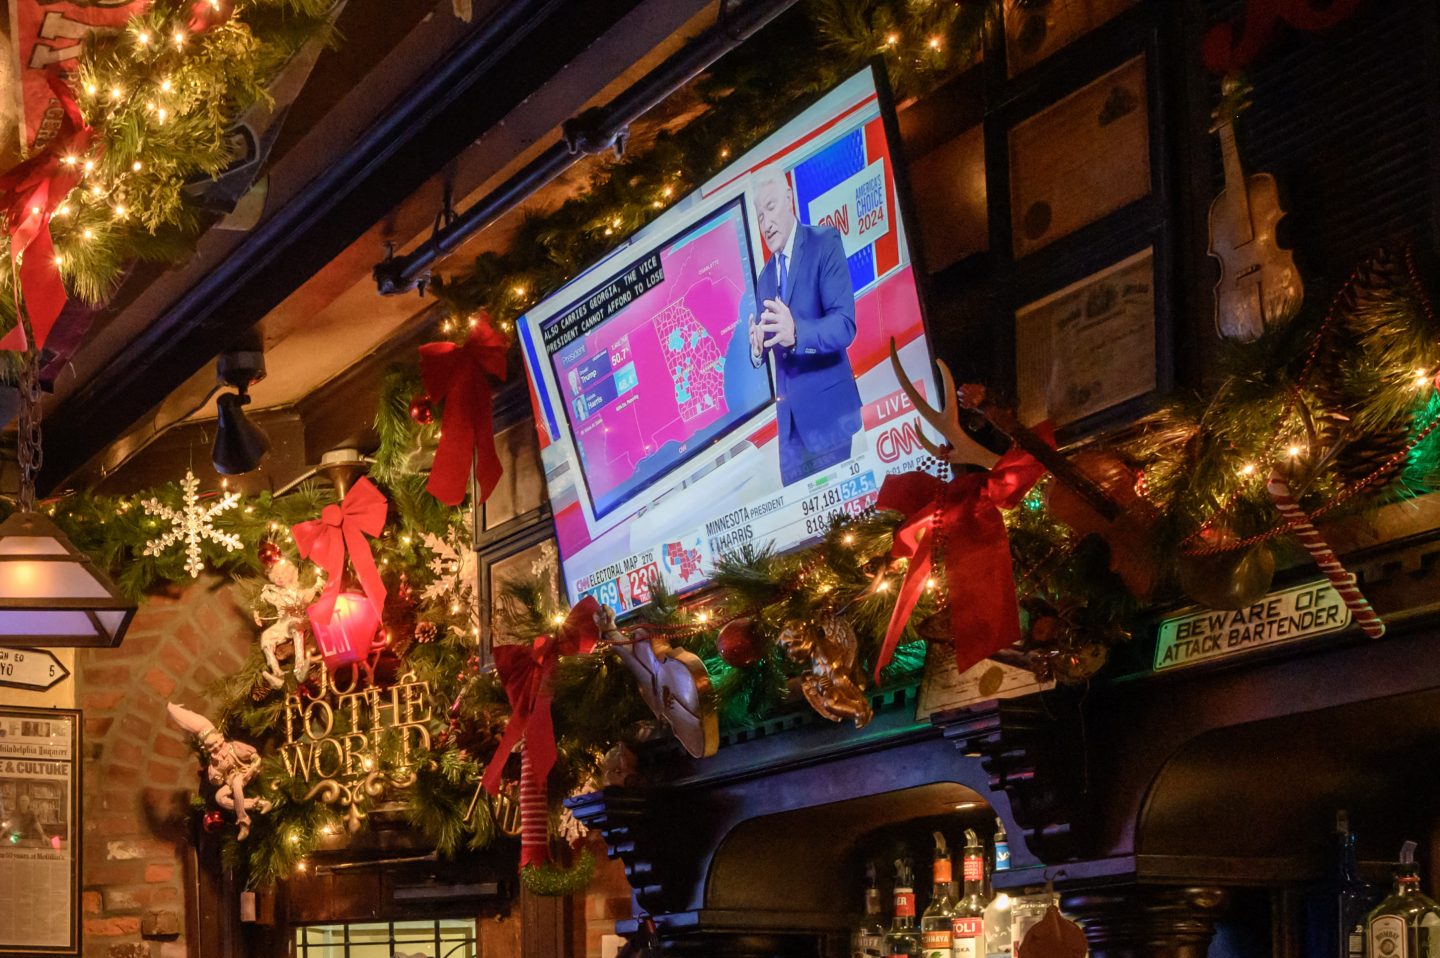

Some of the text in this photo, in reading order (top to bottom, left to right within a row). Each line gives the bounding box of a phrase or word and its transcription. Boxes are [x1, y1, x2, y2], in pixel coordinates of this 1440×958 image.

[856, 174, 882, 200] AMERICA'S
[856, 188, 883, 218] CHOICE
[858, 206, 883, 235] 2024
[544, 256, 658, 340] ALSO CARRIES GEORGIA, THE VICE
[546, 268, 664, 354] PRESIDENT CANNOT AFFORD TO LOSE
[876, 392, 911, 420] LIVE
[876, 416, 924, 464] CNN
[849, 462, 860, 476] 10
[902, 461, 915, 473] PM
[705, 496, 785, 537] MINNESOTA PRESIDENT
[719, 488, 842, 549] HARRIS 947,181
[589, 563, 623, 587] ELECTORAL
[624, 555, 638, 573] MAP
[641, 552, 654, 566] 270
[1176, 585, 1333, 641] BEWARE OF
[1163, 634, 1221, 663] ATTACK
[49, 664, 55, 679] 5
[339, 681, 432, 734] THE
[5, 761, 68, 776] & CULTURE
